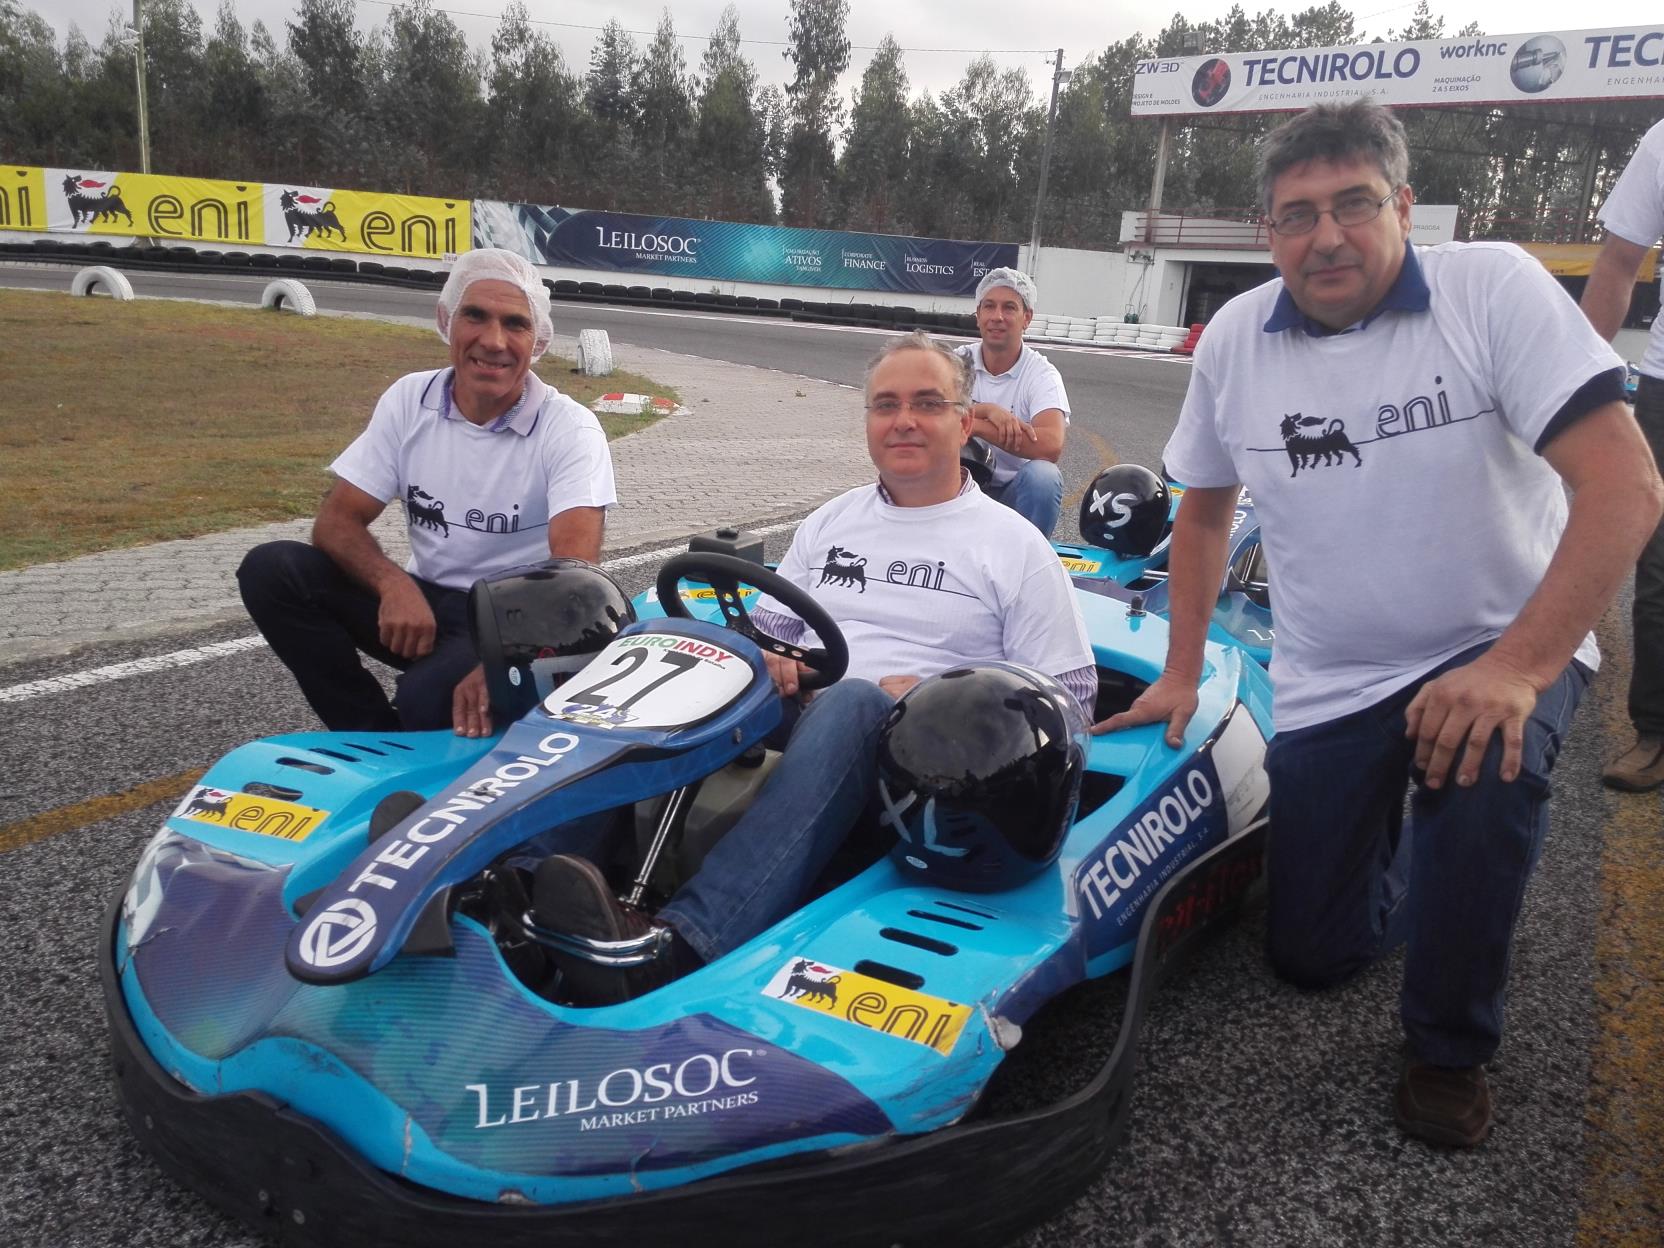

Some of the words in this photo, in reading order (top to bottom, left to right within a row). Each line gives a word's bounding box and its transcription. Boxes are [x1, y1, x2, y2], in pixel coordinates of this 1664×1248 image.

[1243, 48, 1421, 87] TECNIROLO
[1440, 39, 1508, 60] worknc
[1136, 62, 1181, 75] ZW3D
[1258, 92, 1311, 100] ENGENHARIA
[147, 185, 250, 241] eni
[360, 202, 457, 255] eni
[596, 226, 697, 255] LEILOSOC
[635, 252, 664, 261] MARKET
[664, 255, 697, 264] PARTNERS
[784, 255, 822, 266] ATIVOS
[844, 258, 887, 270] FINANCE
[906, 263, 954, 275] LOGISTICS
[1376, 375, 1451, 439] eni
[465, 503, 520, 533] eni
[1089, 489, 1138, 528] XS
[886, 560, 946, 590] eni
[619, 636, 735, 662] EUROINDY
[565, 646, 702, 712] 27
[229, 806, 321, 840] eni
[348, 732, 580, 892] TECNIROLO
[879, 778, 969, 857] XL
[1080, 769, 1212, 920] TECNIROLO
[846, 991, 958, 1049] eni
[465, 1049, 757, 1128] LEILOSOC
[580, 1109, 660, 1131] MARKET
[664, 1091, 759, 1118] PARTNERS
